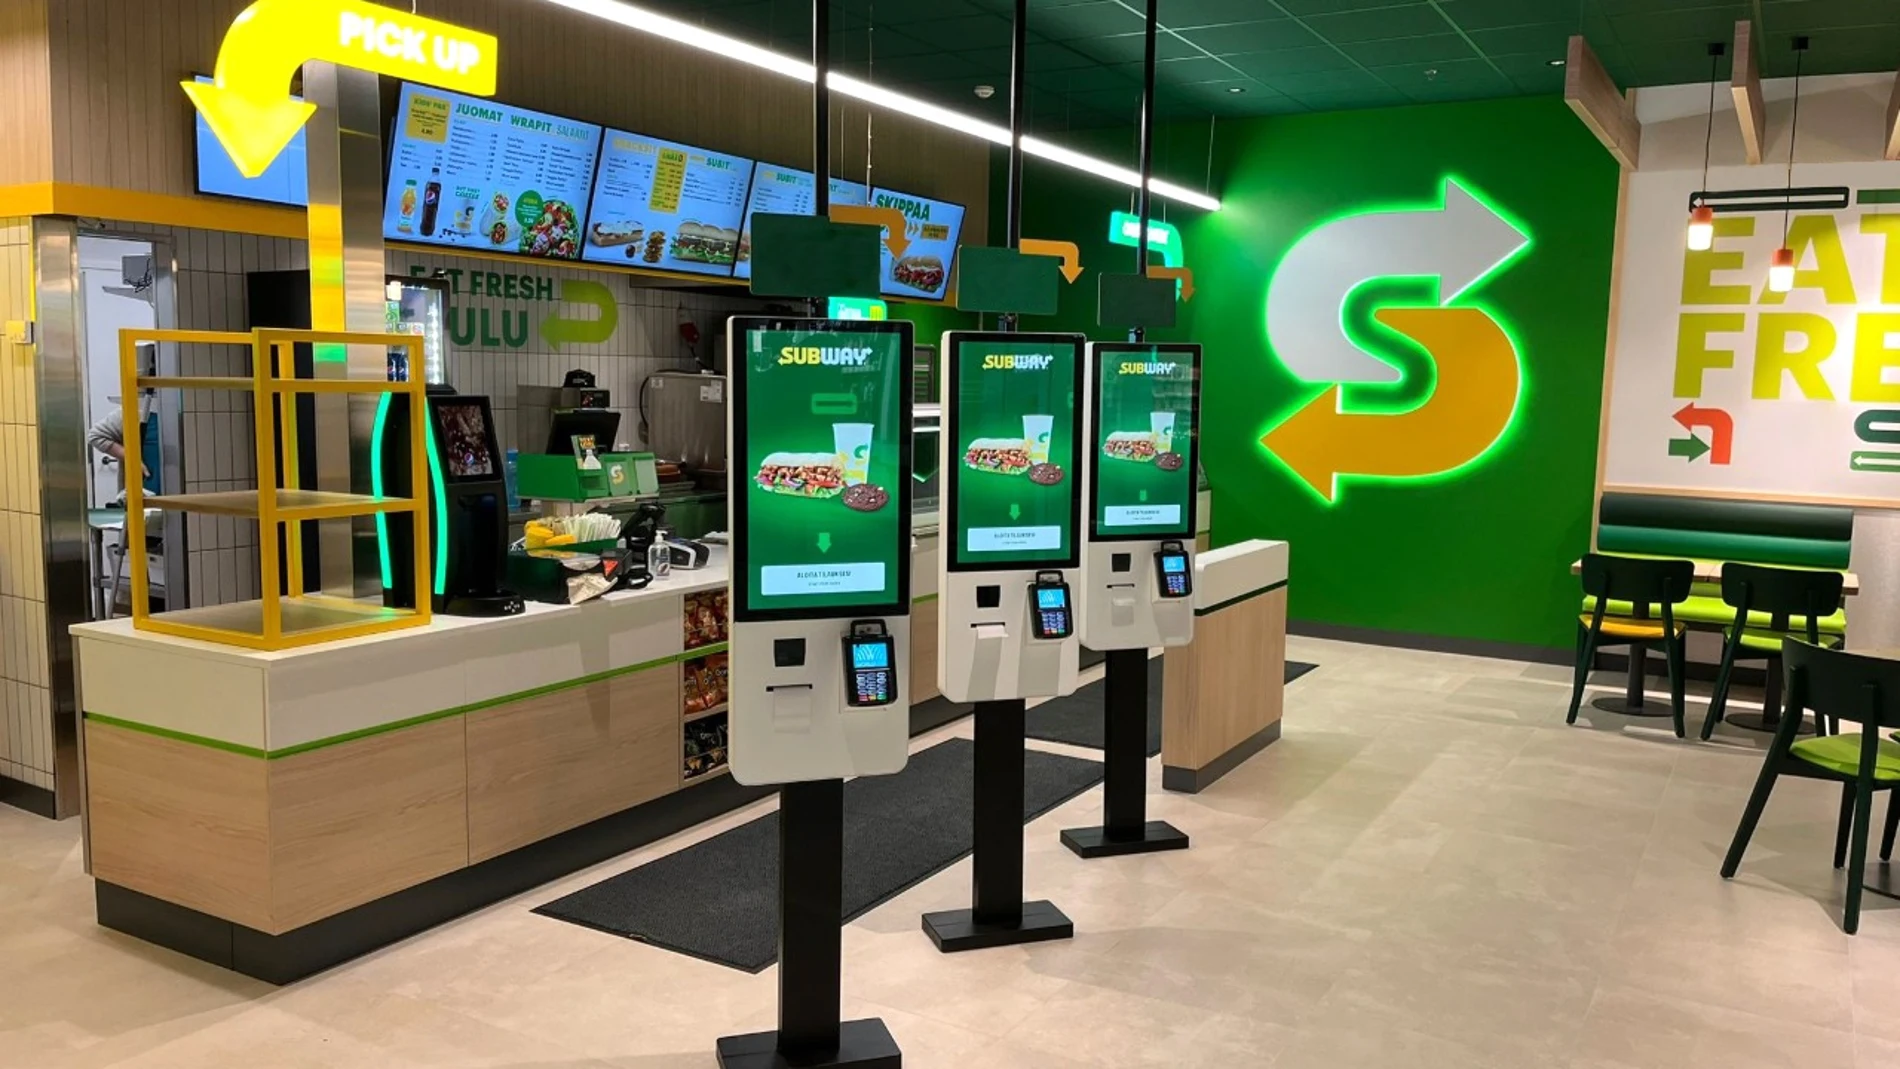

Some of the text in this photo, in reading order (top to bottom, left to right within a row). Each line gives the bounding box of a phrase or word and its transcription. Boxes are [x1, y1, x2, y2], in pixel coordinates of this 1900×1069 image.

[340, 11, 481, 75] PICK UP
[456, 103, 503, 122] JUOMAT
[511, 114, 552, 133] WRAPIT
[706, 157, 731, 170] SUBIT
[776, 172, 798, 185] SUBIT
[1680, 213, 1900, 306] EAT
[471, 270, 553, 301] FRESH
[778, 346, 873, 366] SUBWAY
[982, 353, 1053, 370] SUBWAY
[1119, 362, 1176, 375] SUBWAY
